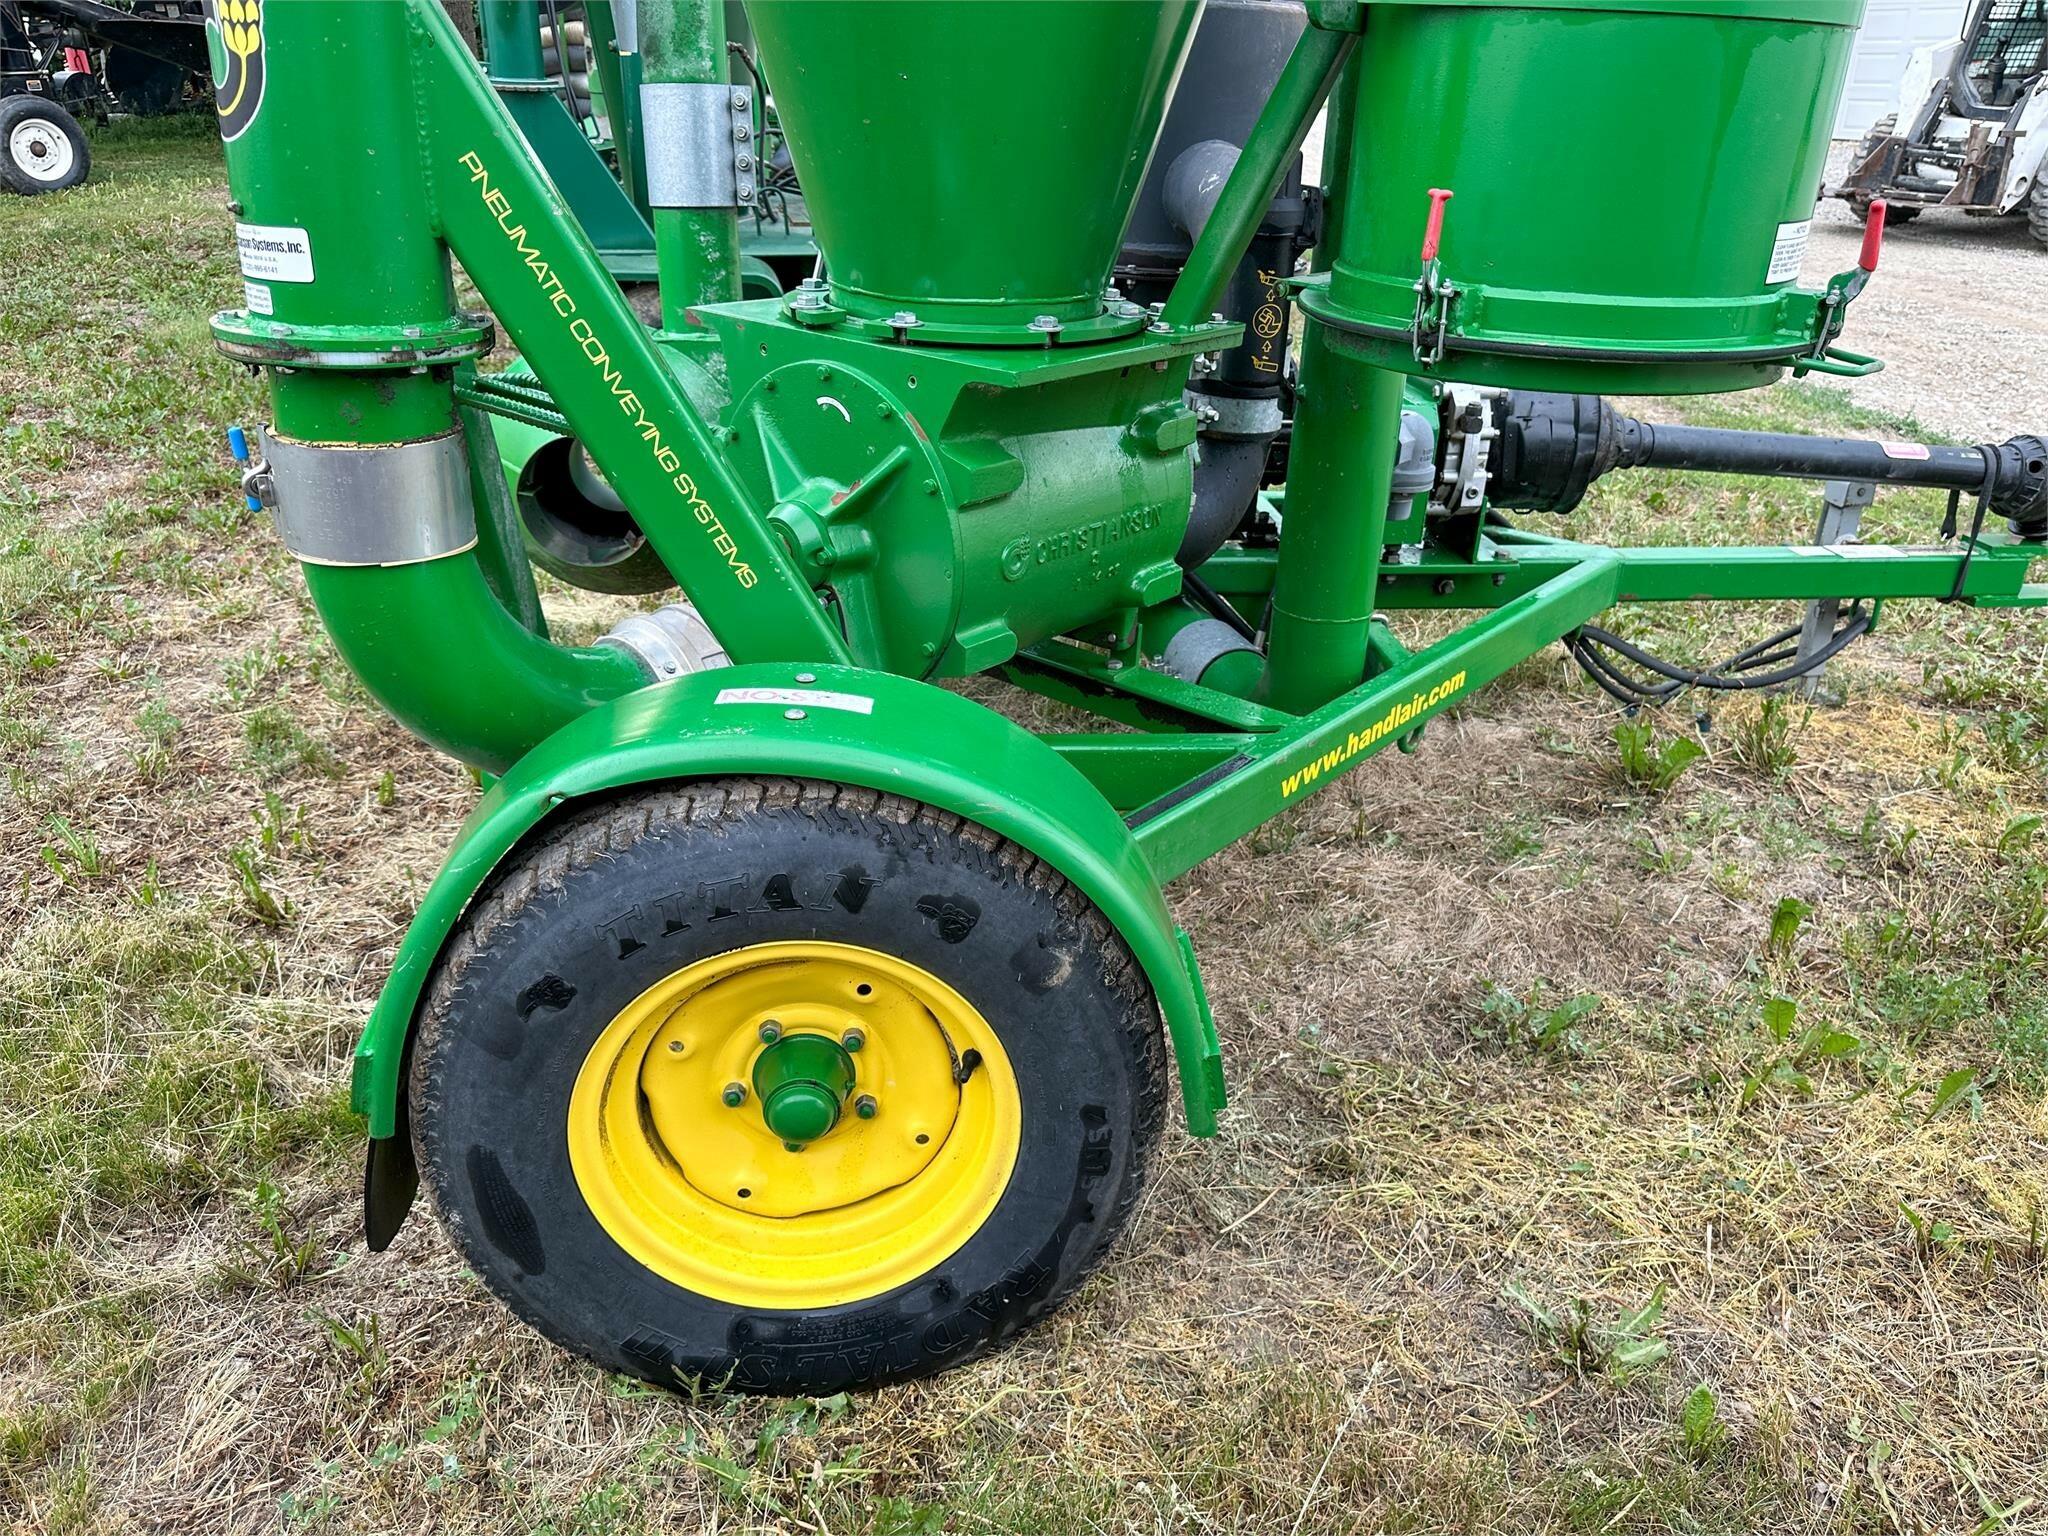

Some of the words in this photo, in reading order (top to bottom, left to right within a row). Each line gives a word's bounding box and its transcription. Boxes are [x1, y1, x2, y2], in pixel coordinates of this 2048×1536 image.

[287, 241, 306, 254] Inc.
[458, 150, 576, 318] PNEUMATIC
[569, 318, 681, 473] CONVEYING
[673, 473, 758, 589] SYSTEMS
[1036, 503, 1162, 564] CHRISTIANSON
[1281, 670, 1466, 799] www.handlair.com
[594, 872, 884, 960] TITAN
[797, 1247, 1053, 1387] RADIAL
